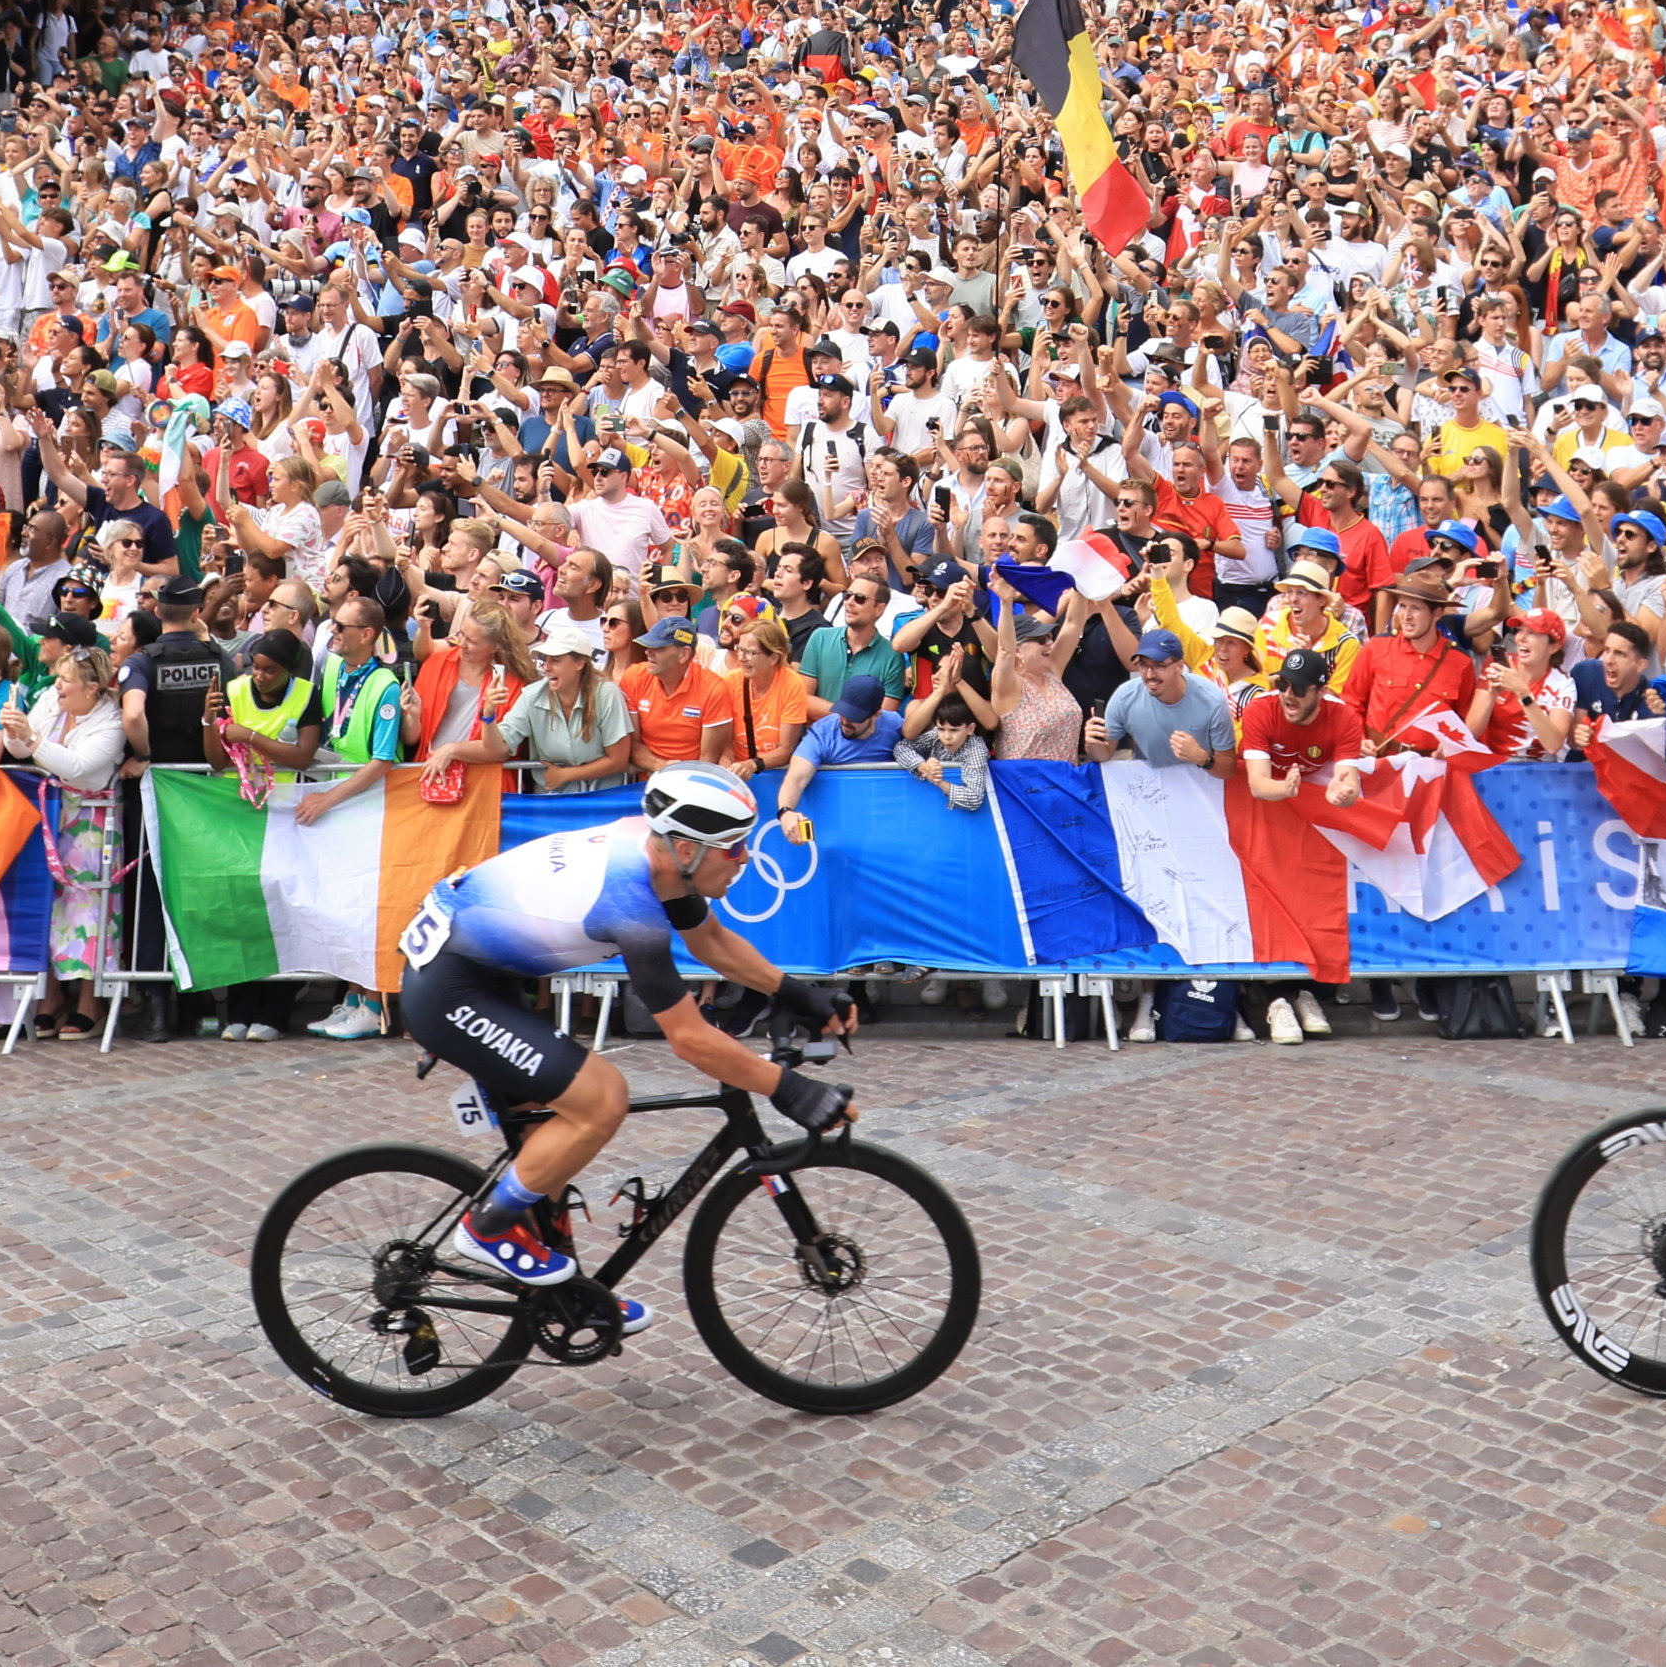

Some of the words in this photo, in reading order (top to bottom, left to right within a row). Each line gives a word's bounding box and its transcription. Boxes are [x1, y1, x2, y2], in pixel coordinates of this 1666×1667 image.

[1187, 990, 1215, 1003] adidas
[445, 1005, 545, 1077] SLOVAKIA
[455, 1095, 484, 1125] 75
